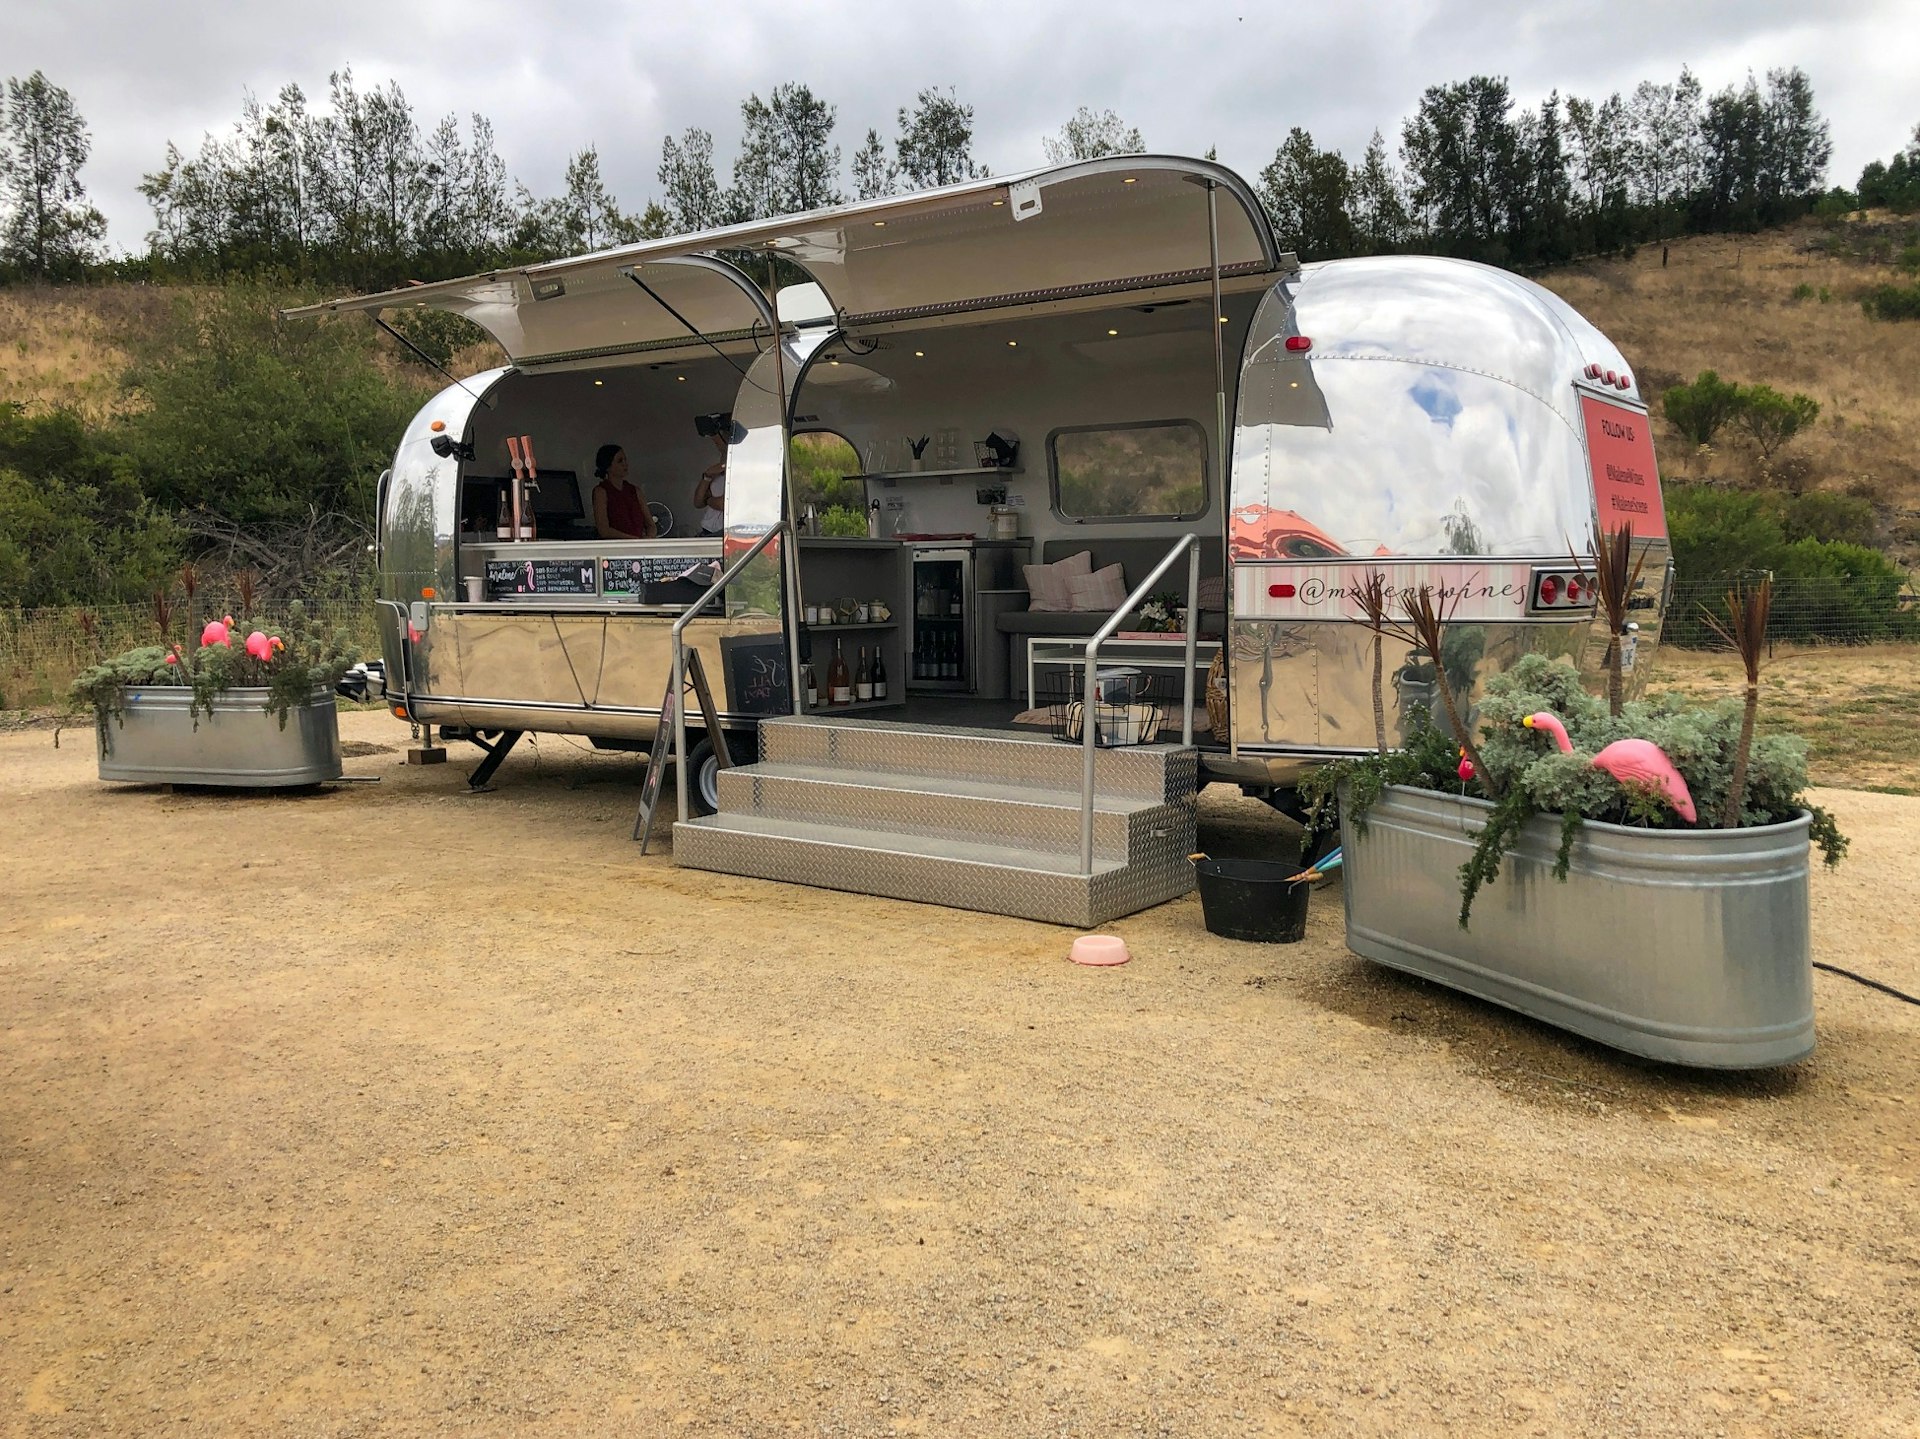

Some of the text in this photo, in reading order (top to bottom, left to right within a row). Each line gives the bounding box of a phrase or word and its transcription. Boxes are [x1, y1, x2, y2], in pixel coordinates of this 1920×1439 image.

[1601, 419, 1625, 439] FOLLOW
[580, 567, 593, 584] M
[604, 570, 627, 580] TO SUN
